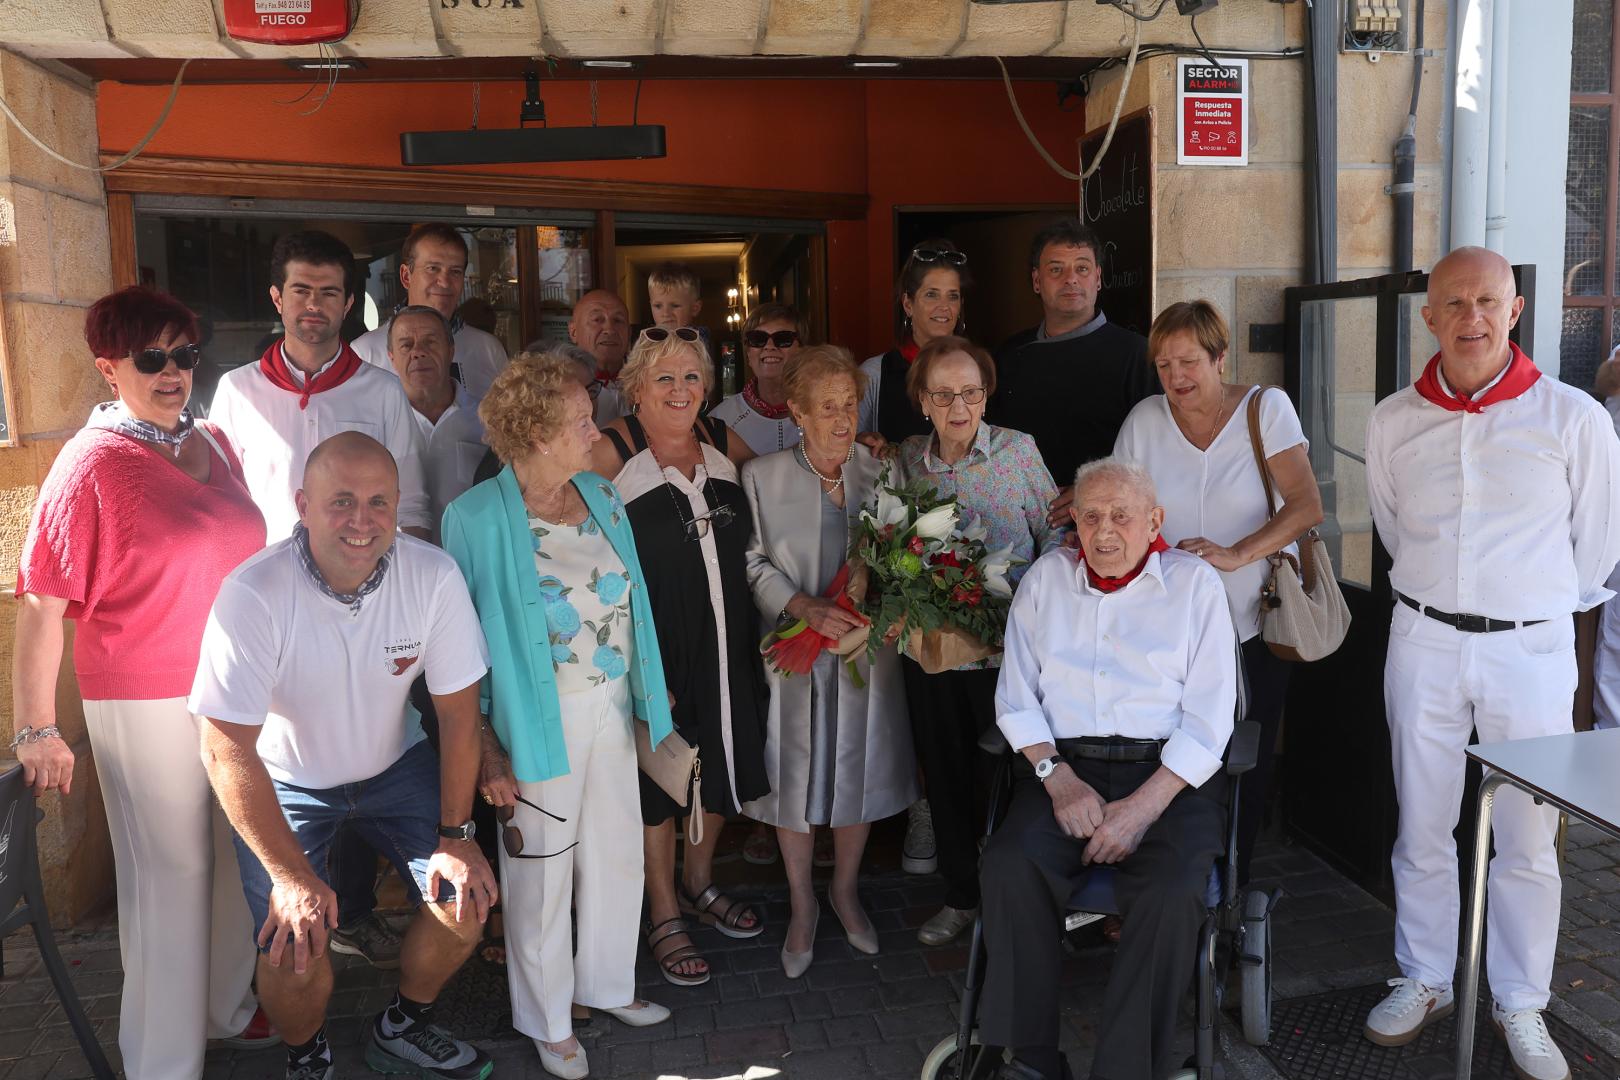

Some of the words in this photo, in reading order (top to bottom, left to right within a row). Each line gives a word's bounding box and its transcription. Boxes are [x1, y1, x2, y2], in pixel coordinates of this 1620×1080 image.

[261, 14, 306, 25] FUEGO
[1188, 67, 1238, 79] SECTOR
[1189, 80, 1227, 89] ALARM
[1194, 101, 1232, 110] Respuesta
[1085, 153, 1145, 222] Chocolate
[384, 641, 422, 654] TERNUA
